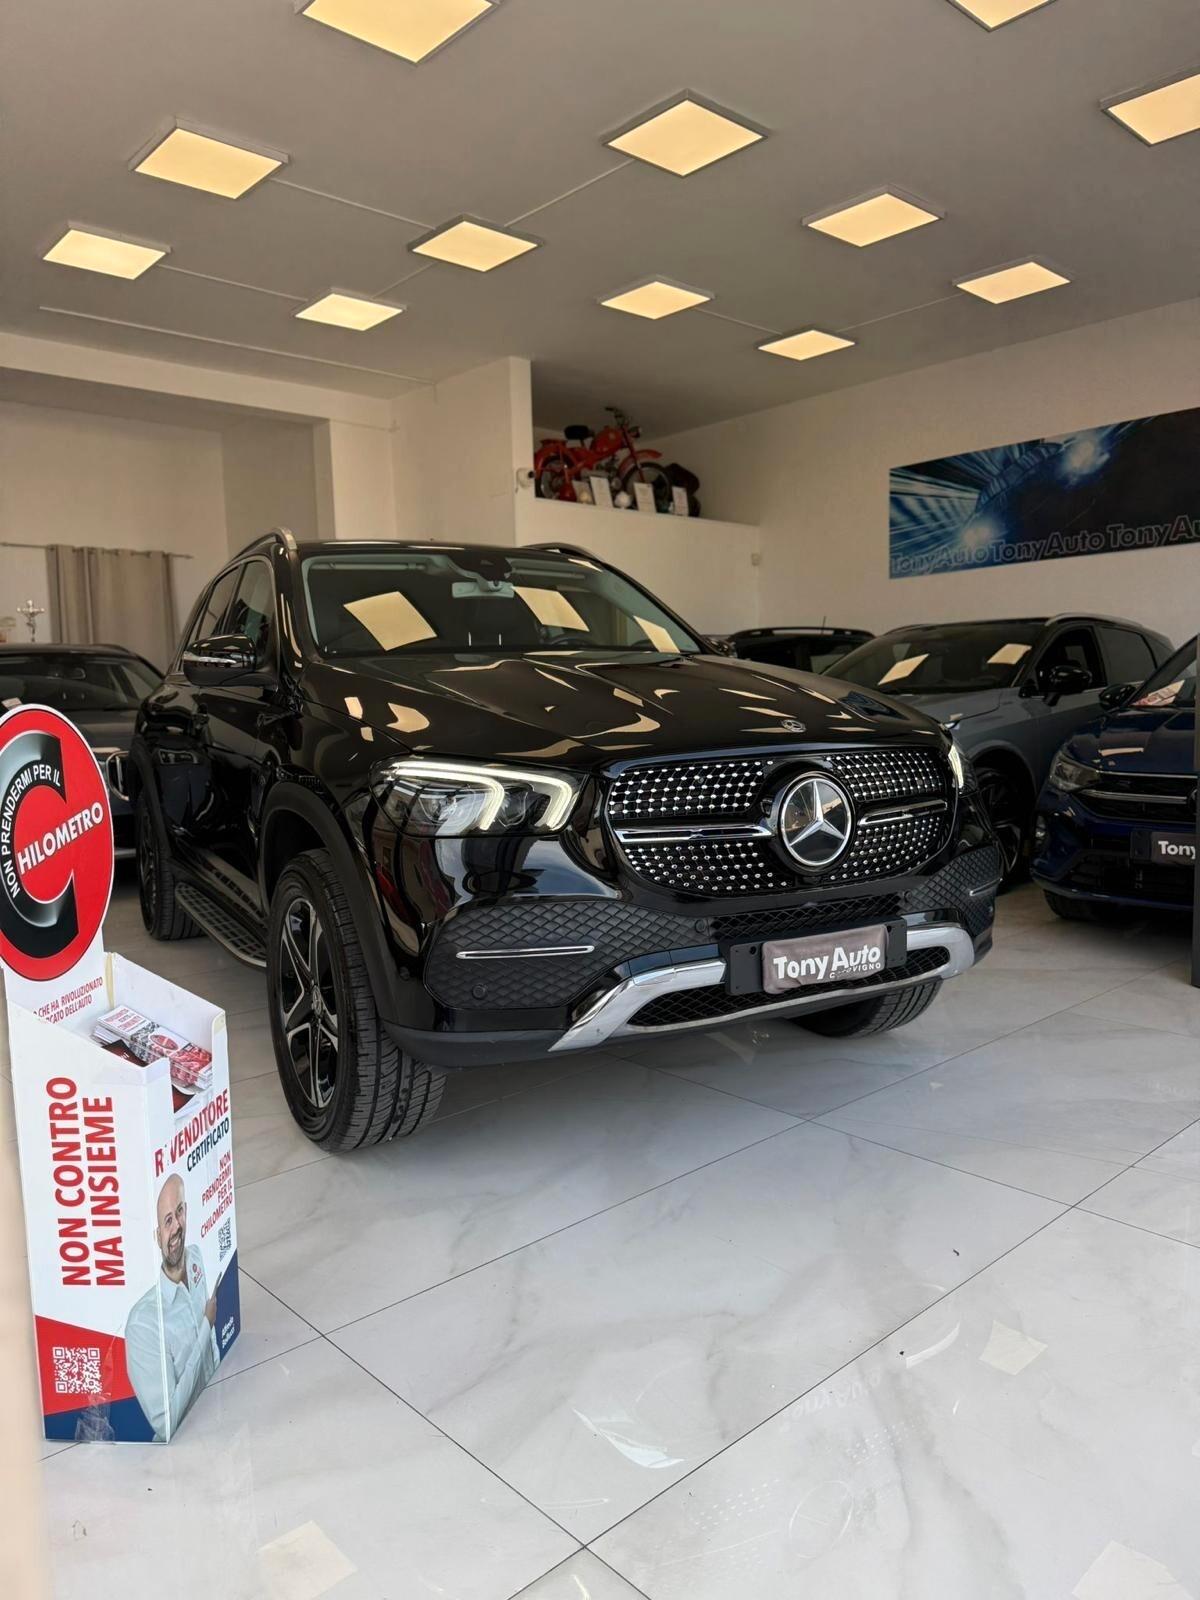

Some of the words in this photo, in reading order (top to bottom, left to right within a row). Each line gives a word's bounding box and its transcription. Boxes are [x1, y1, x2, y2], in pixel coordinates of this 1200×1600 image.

[33, 764, 52, 782] PER
[53, 770, 61, 787] IL
[1, 768, 32, 856] PRENDERMI
[3, 862, 20, 898] NON
[773, 956, 829, 980] Tony
[831, 945, 881, 972] Auto
[38, 1003, 50, 1017] CHE
[50, 999, 59, 1011] HA
[60, 976, 103, 1006] RIVOLUZIONATO
[46, 1077, 86, 1207] CONTRO
[154, 1088, 229, 1178] RVENDITORE
[187, 1117, 230, 1172] CERTIFICATO
[82, 1097, 121, 1227] INSIEME
[219, 1150, 231, 1171] NON
[202, 1163, 232, 1206] PRENDERMI
[218, 1184, 227, 1203] PER
[201, 1192, 232, 1238] CHILOMETRO
[57, 1218, 91, 1286] NON
[94, 1236, 125, 1286] MA
